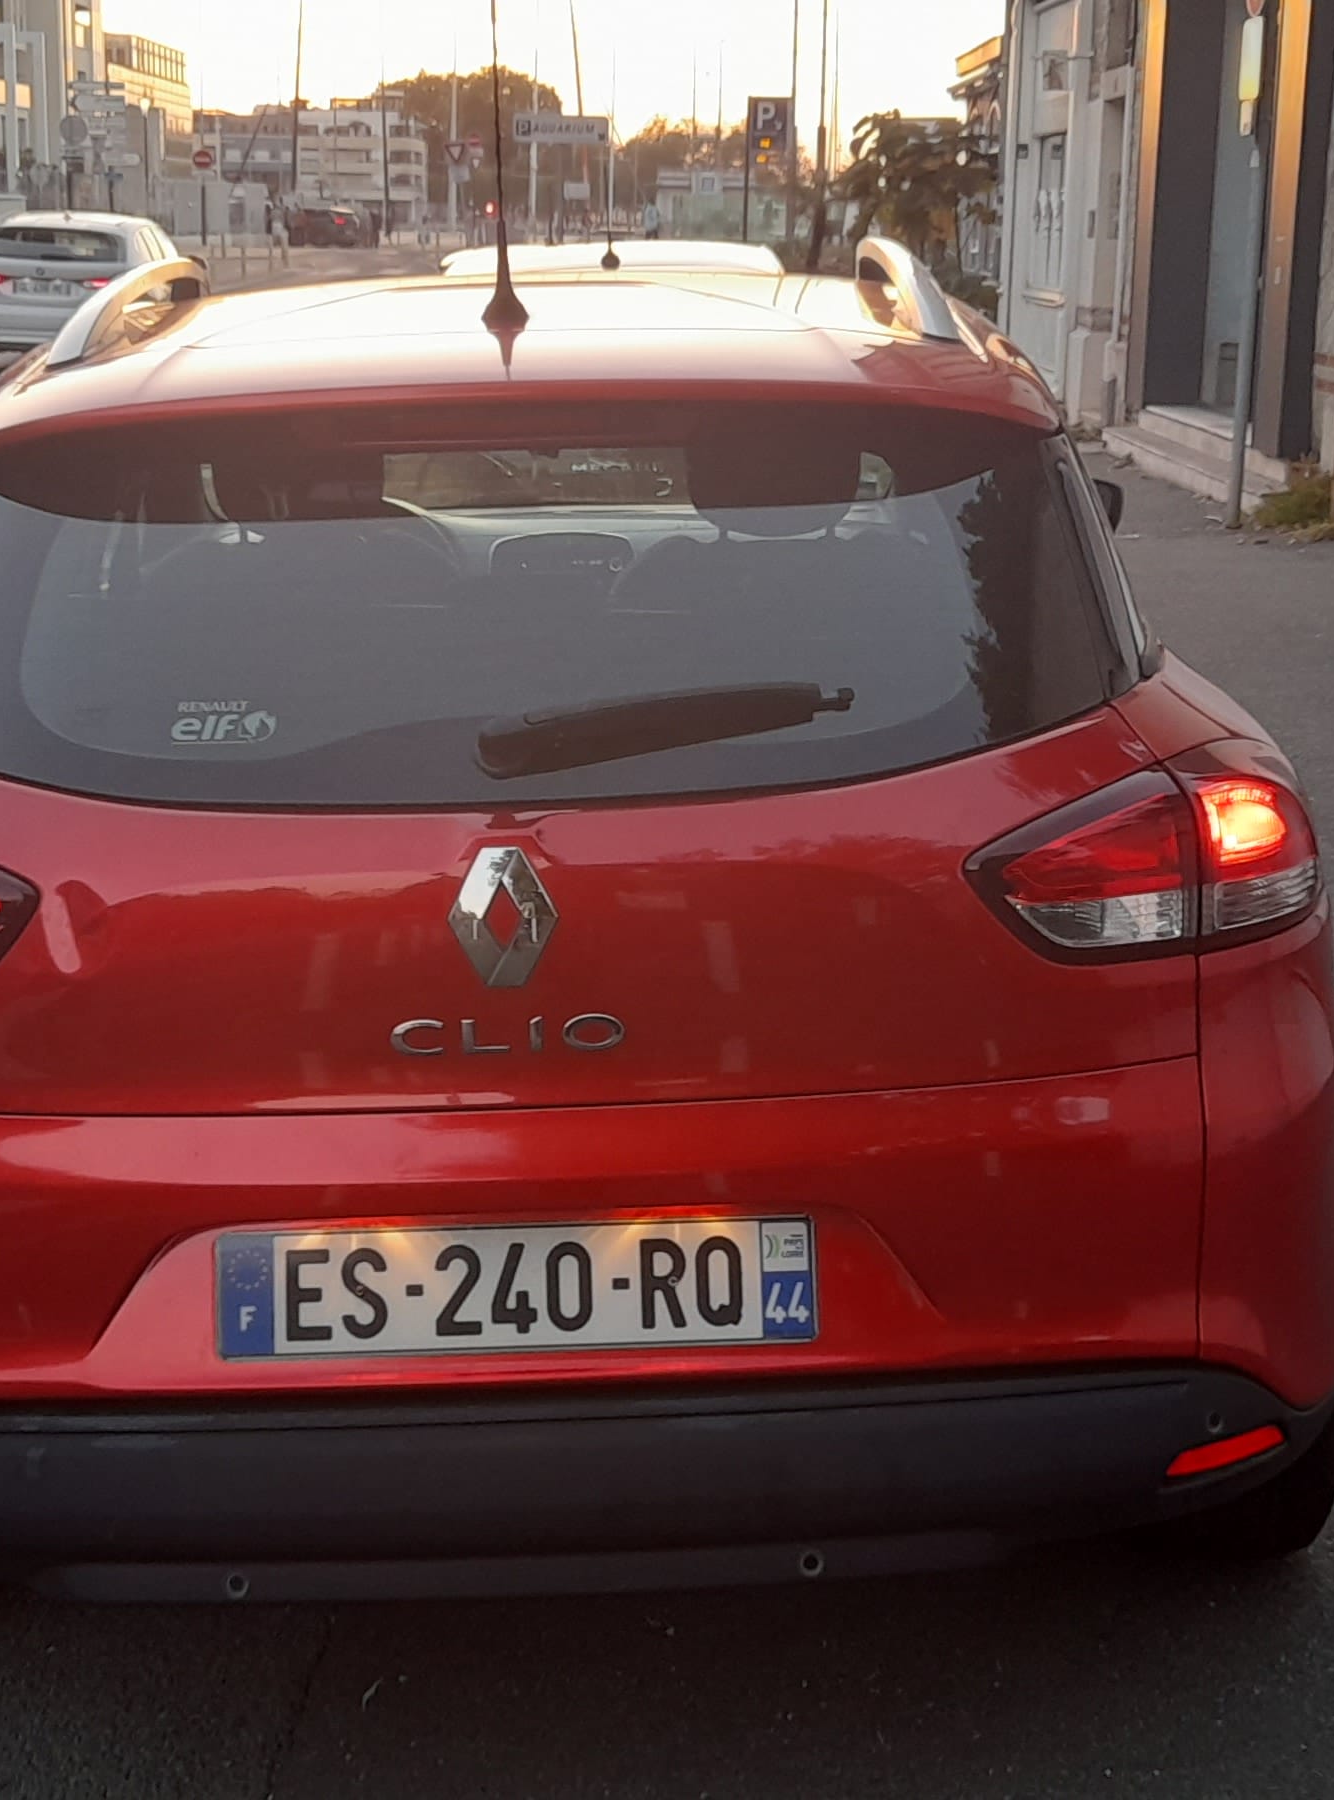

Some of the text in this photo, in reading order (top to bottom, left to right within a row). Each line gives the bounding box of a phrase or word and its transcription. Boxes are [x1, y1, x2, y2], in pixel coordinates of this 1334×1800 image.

[533, 121, 595, 134] AQUARIUM
[757, 101, 776, 130] P
[178, 701, 250, 713] RENAULT
[170, 714, 240, 741] elf
[390, 1012, 625, 1056] CLIO
[284, 1236, 743, 1342] ES-240-RQ
[764, 1281, 810, 1324] 44
[239, 1305, 257, 1332] F
